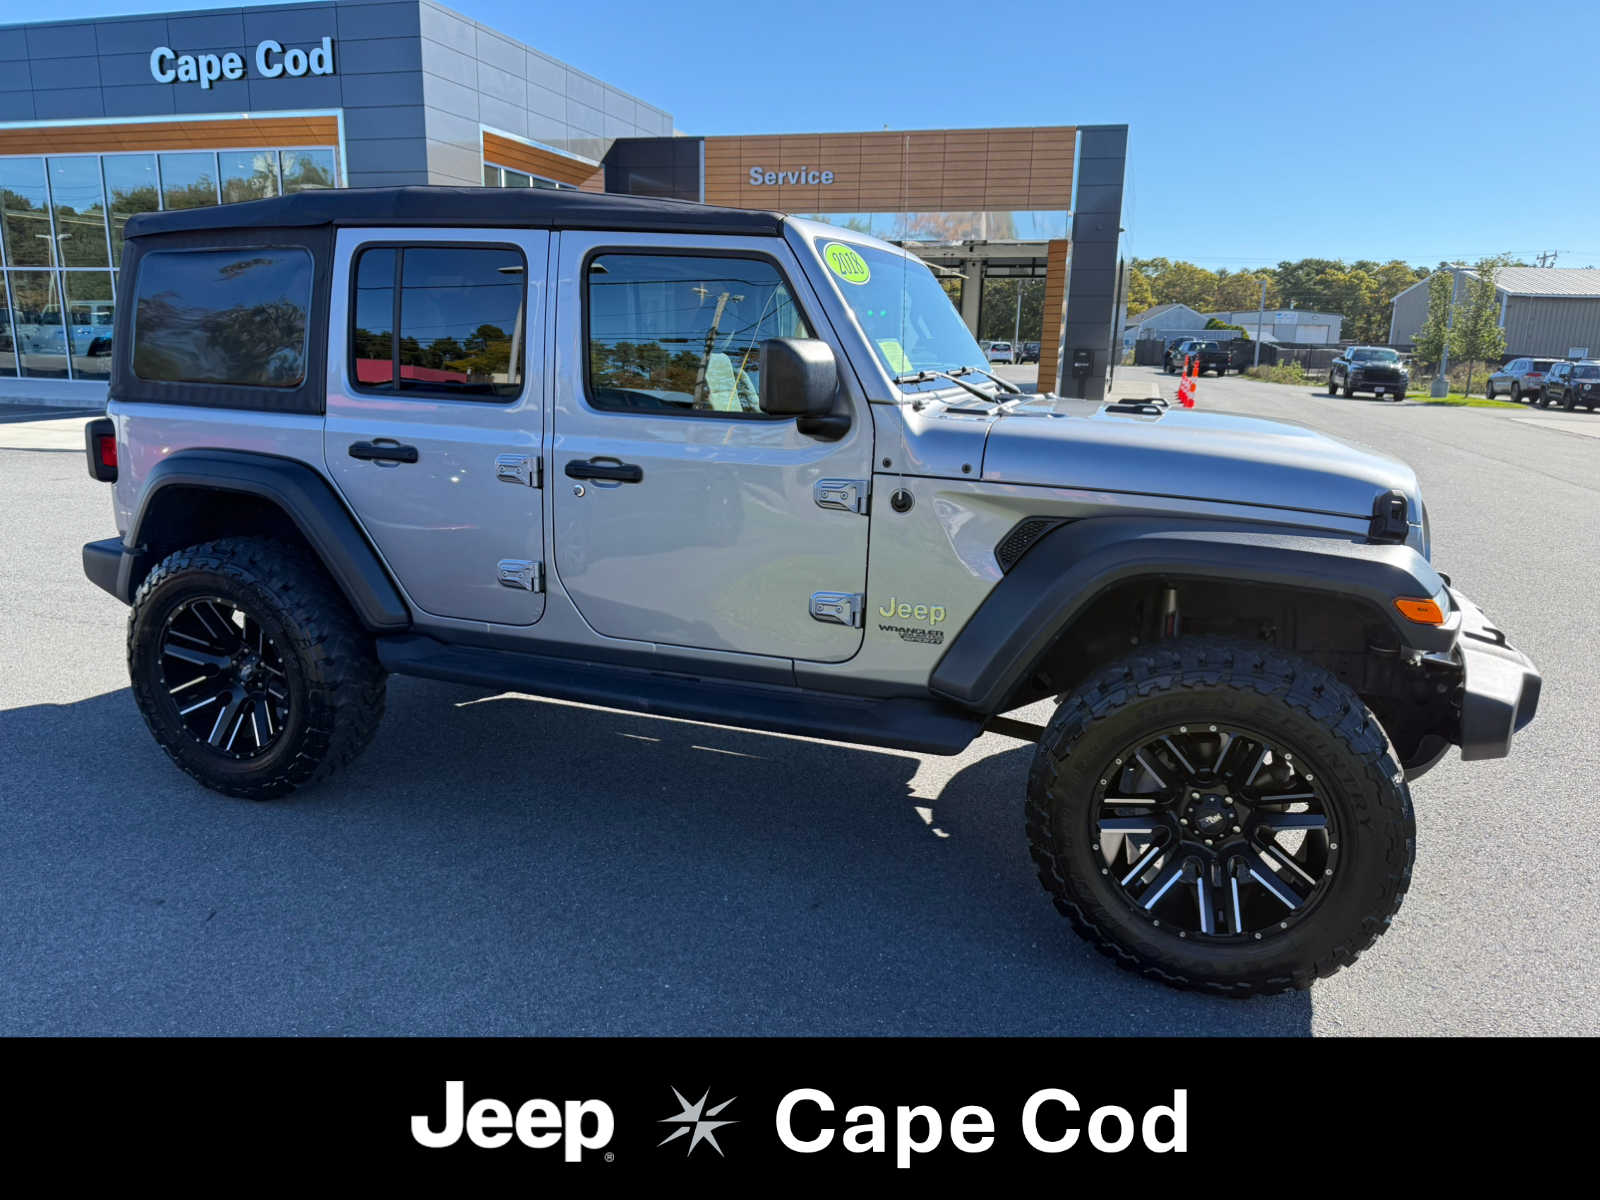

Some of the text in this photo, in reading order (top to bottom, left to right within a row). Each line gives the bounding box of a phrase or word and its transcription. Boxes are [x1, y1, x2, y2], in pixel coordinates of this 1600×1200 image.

[150, 36, 335, 89] Cape Cod
[749, 165, 834, 186] Service
[879, 597, 946, 625] Jeep
[878, 624, 944, 637] WRANGLER
